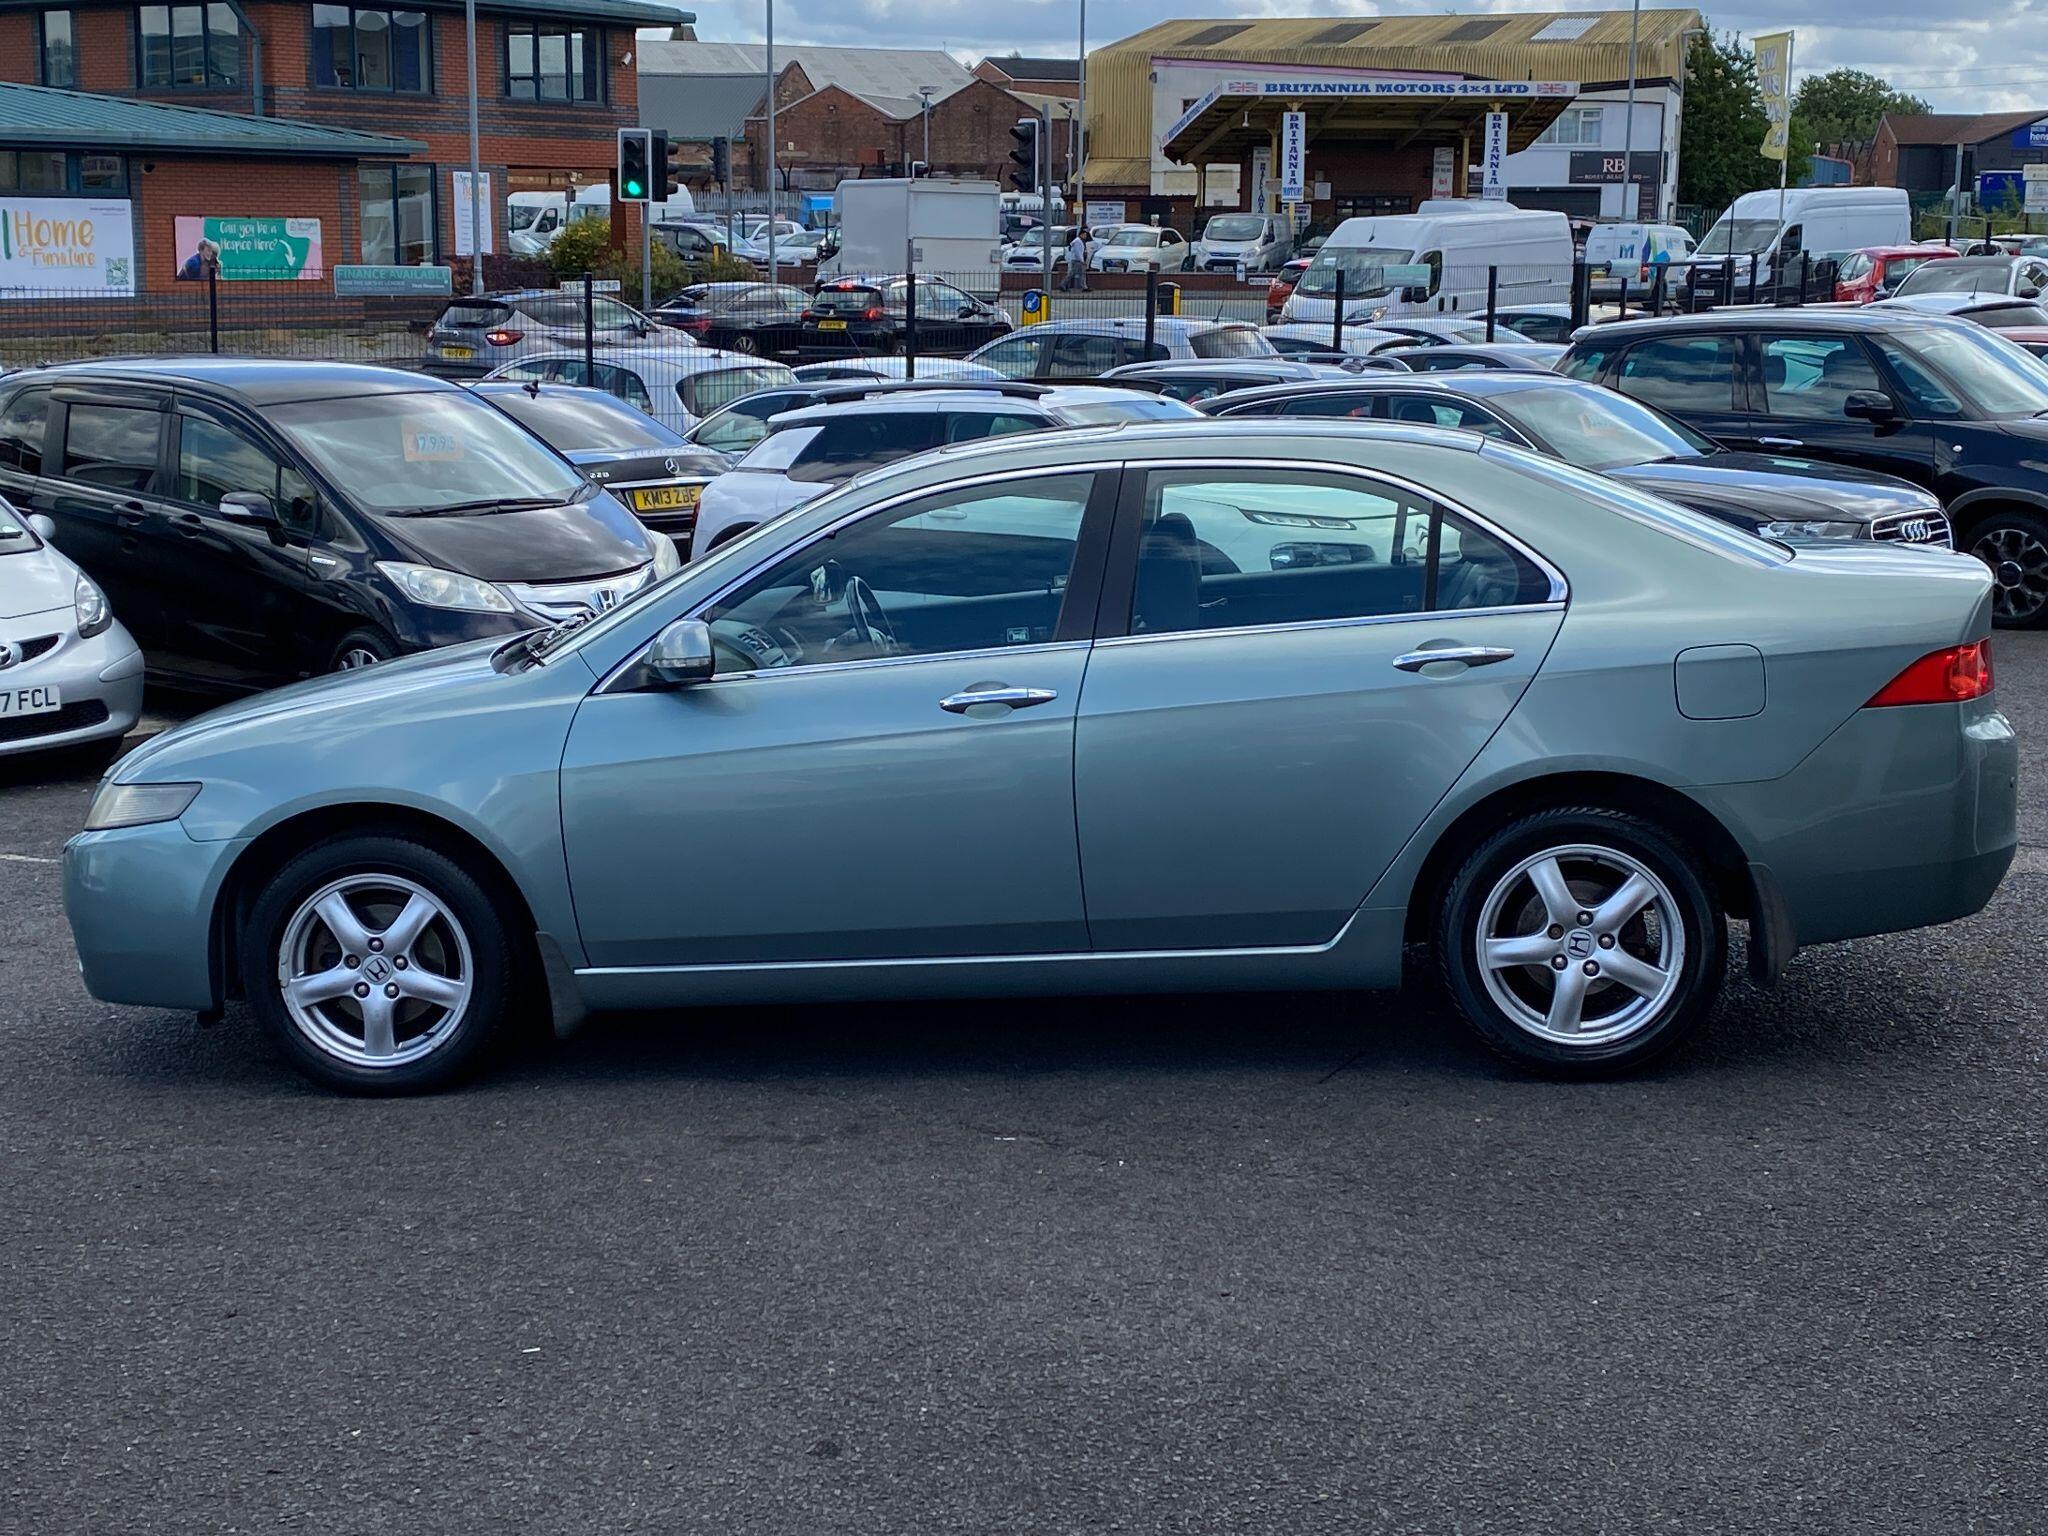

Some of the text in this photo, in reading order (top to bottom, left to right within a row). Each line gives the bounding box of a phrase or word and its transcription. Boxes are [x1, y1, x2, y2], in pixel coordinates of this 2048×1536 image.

[1264, 83, 1529, 93] BRITANNIA MOTORS 4x4 LTD
[1287, 114, 1300, 186] BRITANNIA
[1488, 113, 1502, 185] BRITANNIA
[1602, 158, 1626, 173] RB
[14, 210, 94, 248] Home
[219, 220, 277, 239] Can you be a
[219, 238, 252, 255] Hospice
[33, 247, 96, 267] Furniture
[337, 268, 449, 280] FINANCE AVAILABLE
[643, 490, 671, 507] KM13
[18, 687, 57, 710] FCL
